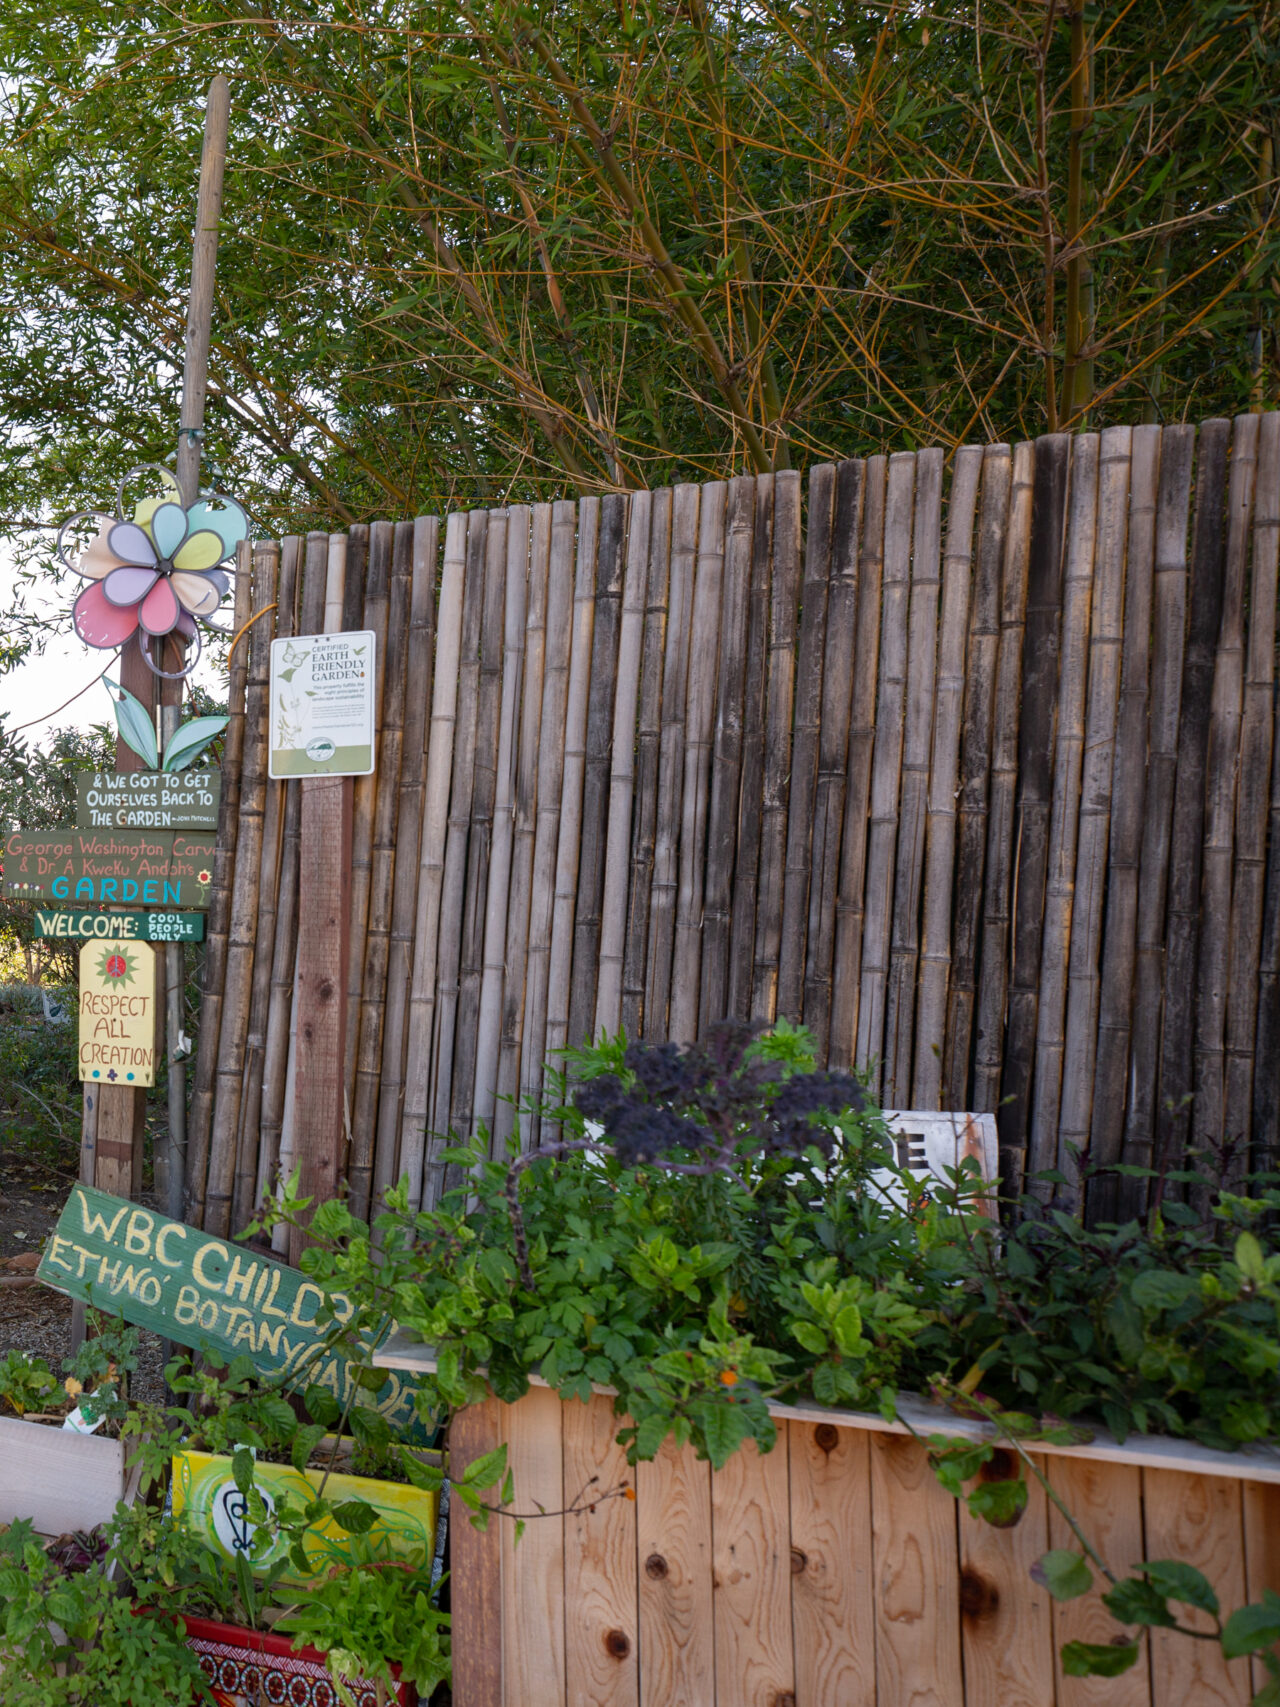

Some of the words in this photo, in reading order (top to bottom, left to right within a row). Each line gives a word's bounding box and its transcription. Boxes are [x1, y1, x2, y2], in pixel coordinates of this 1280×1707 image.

[312, 643, 349, 653] CERTIFIED
[312, 651, 349, 662] EARTH
[312, 659, 366, 672] FRIENDLY
[312, 669, 360, 682] GARDEN
[93, 773, 102, 789] &
[105, 774, 126, 789] WE
[130, 773, 159, 788] GOT
[161, 773, 180, 788] TO
[184, 773, 211, 788] GET
[86, 790, 158, 807] OURSELVES
[161, 789, 195, 806] BACK
[196, 789, 213, 806] TO
[89, 809, 113, 826] THE
[116, 809, 171, 827] GARDEN
[6, 834, 73, 860] George
[79, 835, 164, 861] Washington
[19, 857, 29, 873] &
[38, 857, 57, 875] Dr.
[63, 859, 75, 875] A
[137, 858, 195, 877] Andoh's
[51, 876, 181, 905] GARDEN
[37, 912, 139, 938] WELCOME:
[148, 913, 183, 924] COOL
[148, 923, 193, 934] PEOPLE
[150, 933, 181, 941] ONLY
[81, 991, 150, 1017] RESPECT
[93, 1017, 131, 1039] ALL
[80, 1041, 153, 1067] CREATION
[174, 1285, 304, 1377] BOTANY
